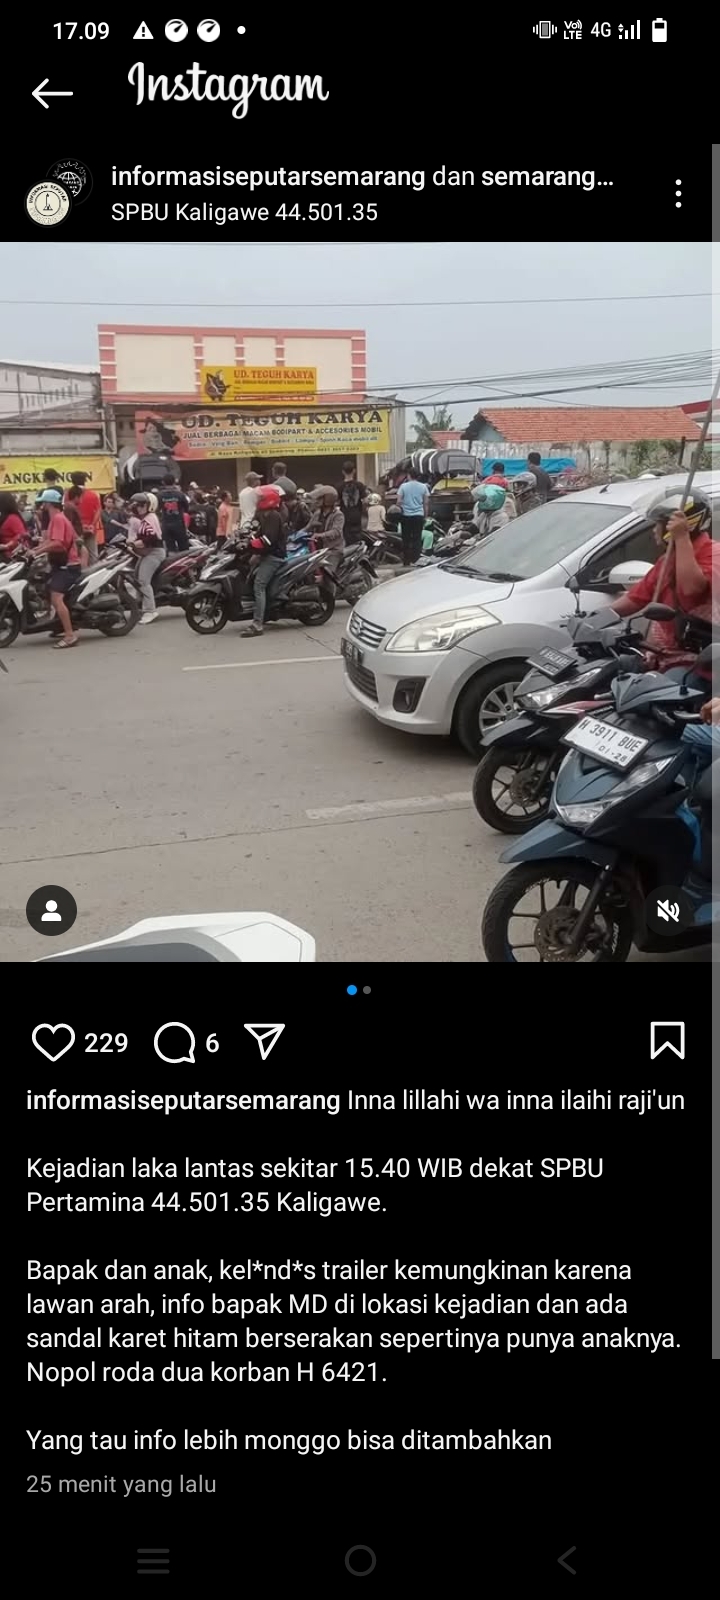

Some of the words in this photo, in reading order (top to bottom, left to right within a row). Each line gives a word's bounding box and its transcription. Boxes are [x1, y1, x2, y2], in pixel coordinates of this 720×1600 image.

[252, 370, 282, 379] TEGUH
[284, 370, 314, 379] KARYA
[226, 412, 301, 427] TEGUH
[308, 409, 383, 424] KARYA
[204, 430, 241, 438] BERBAGAI
[243, 429, 270, 437] MACAM
[578, 719, 591, 731] H
[589, 723, 617, 742] 3911
[618, 736, 642, 753] BUE
